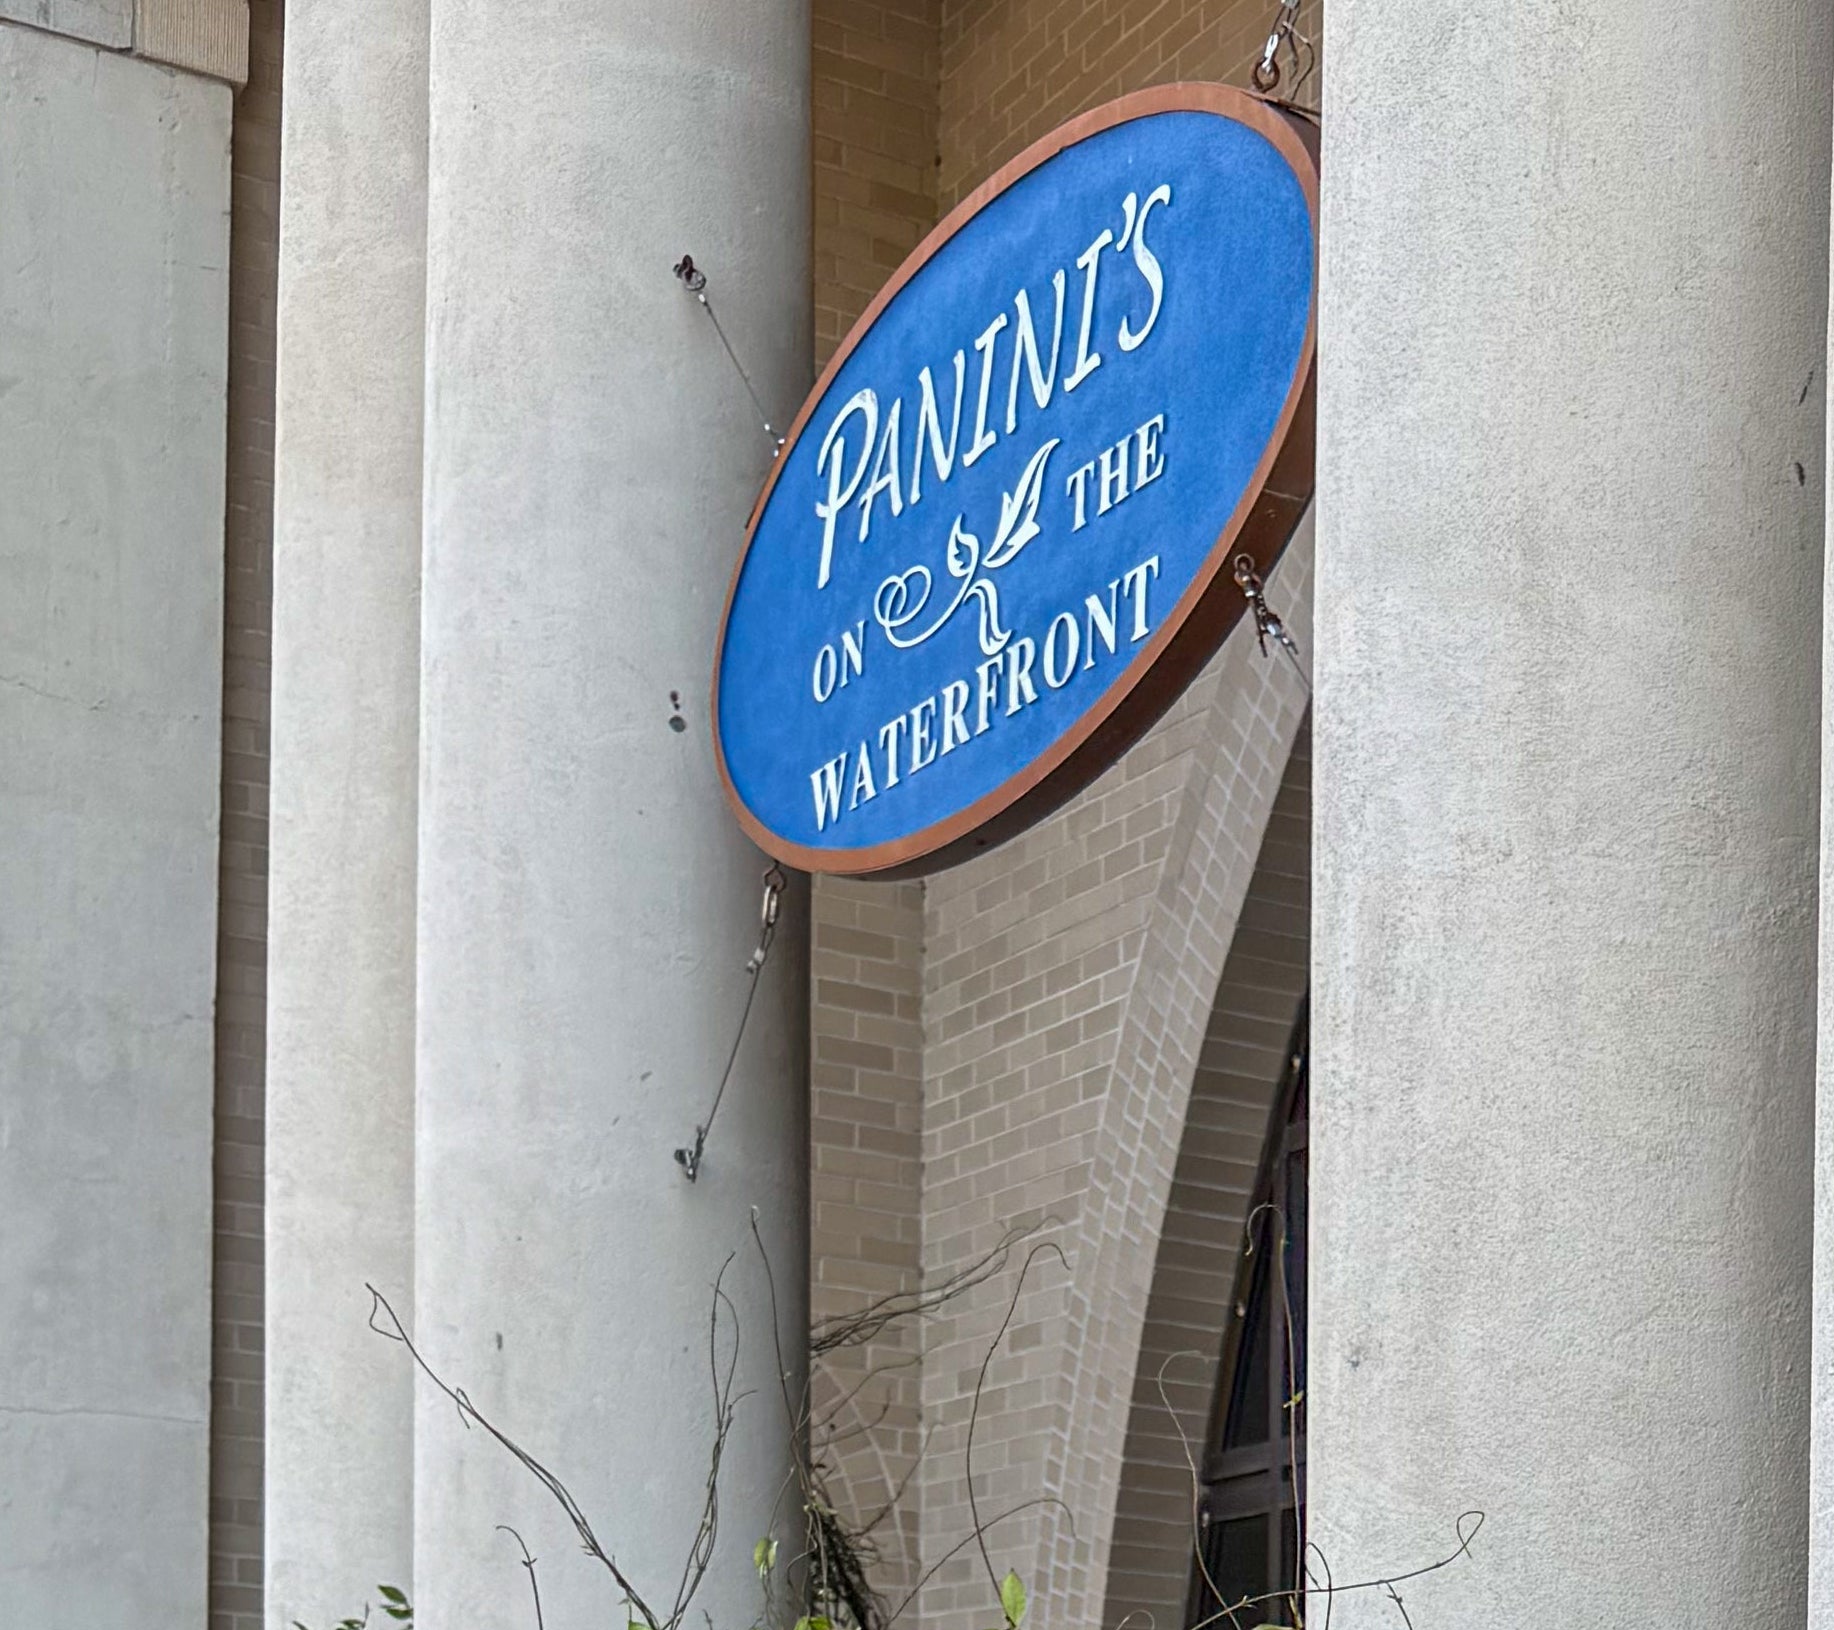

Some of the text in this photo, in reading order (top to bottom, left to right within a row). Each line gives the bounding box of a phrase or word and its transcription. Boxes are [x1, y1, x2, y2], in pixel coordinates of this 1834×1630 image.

[815, 183, 1171, 589] PANINI'S
[808, 555, 1161, 832] WATERFRONT
[811, 413, 1166, 704] ON THE
